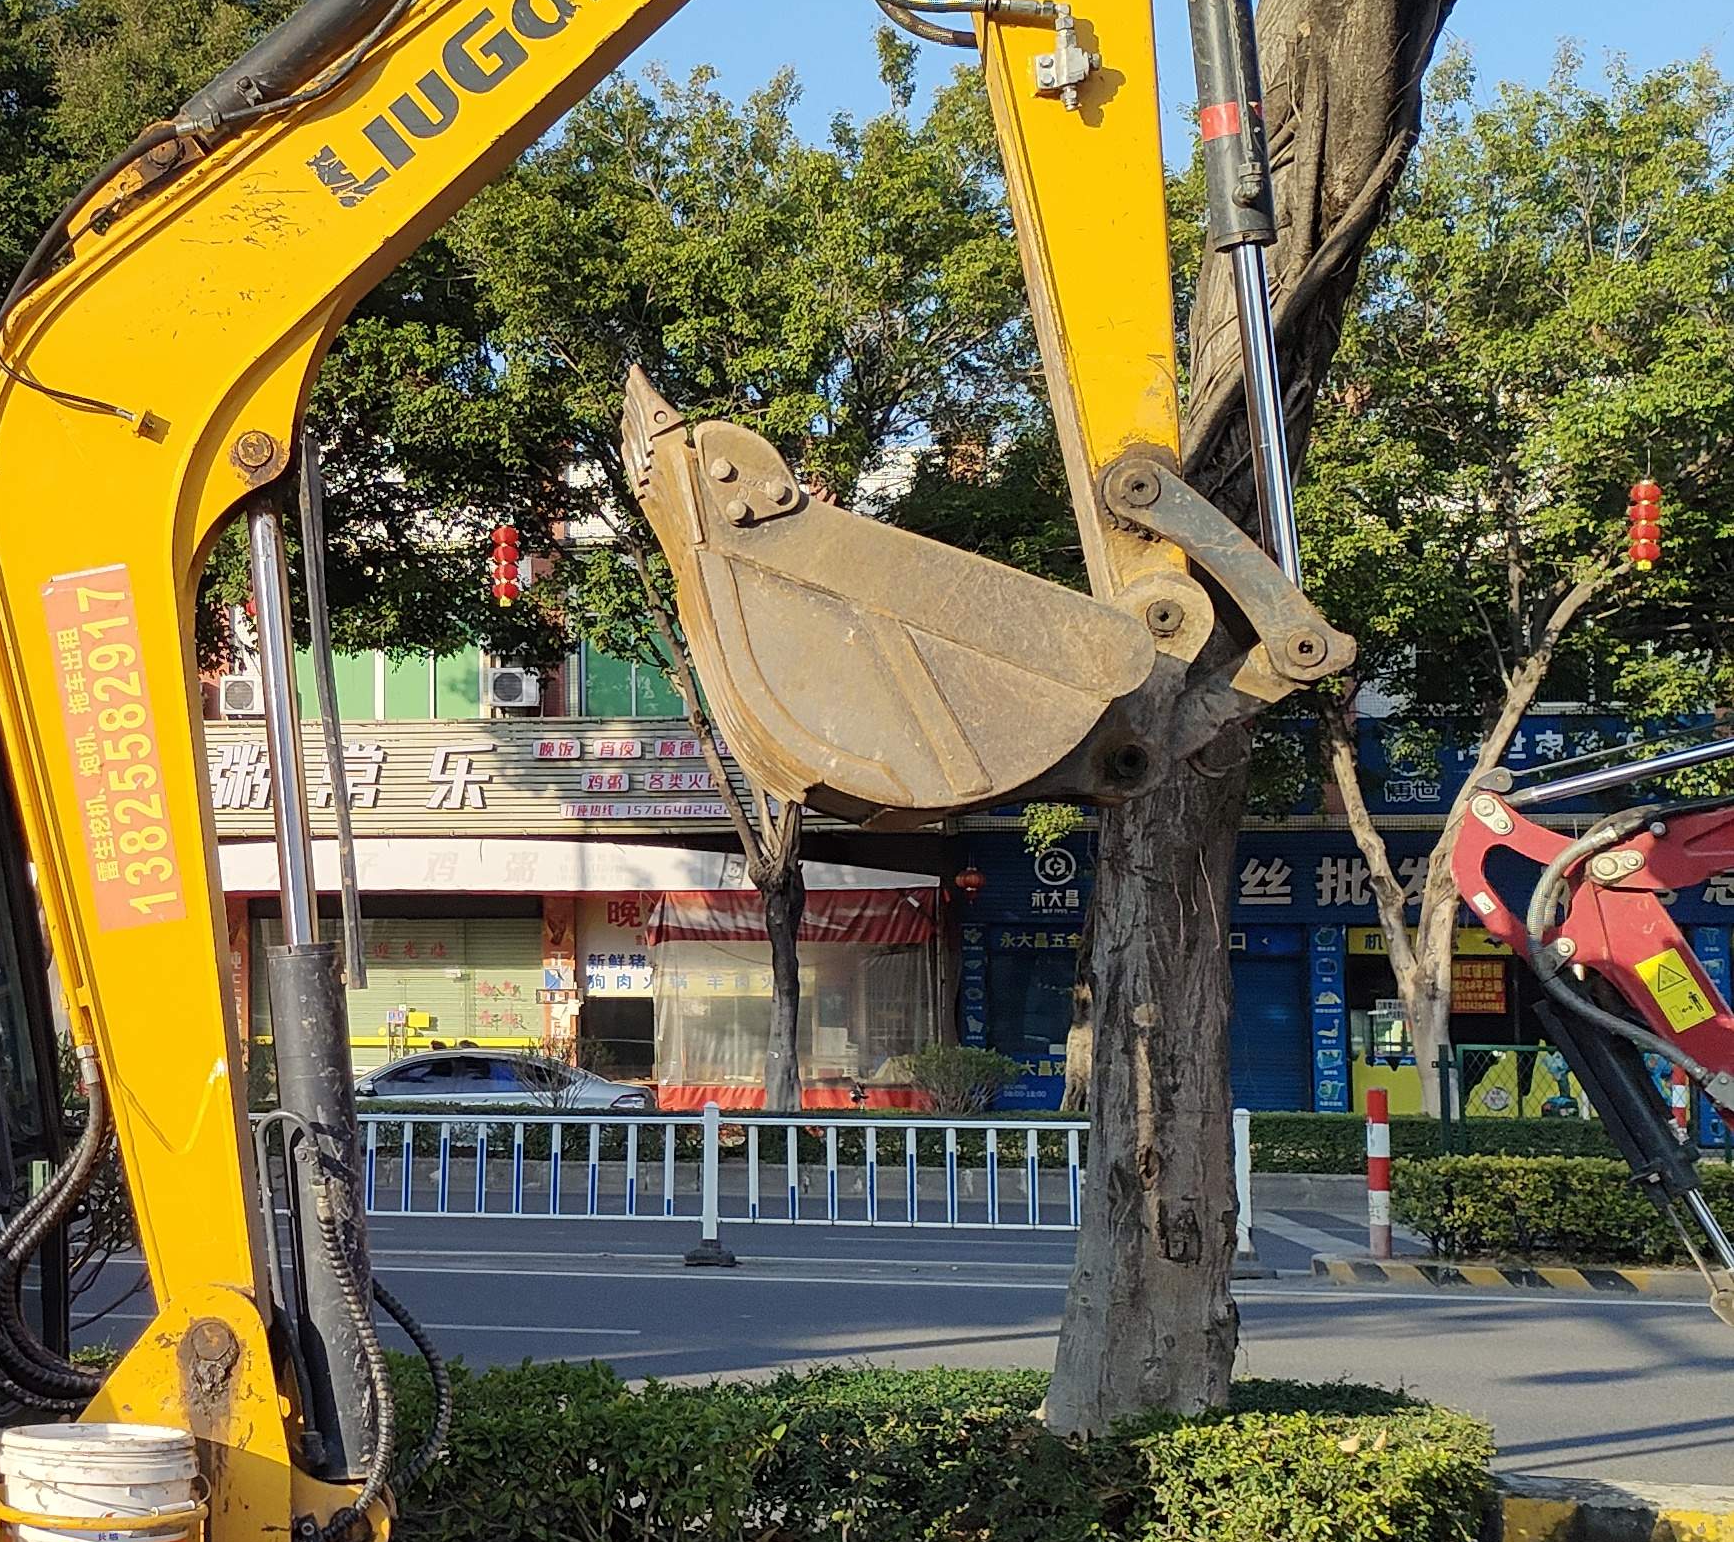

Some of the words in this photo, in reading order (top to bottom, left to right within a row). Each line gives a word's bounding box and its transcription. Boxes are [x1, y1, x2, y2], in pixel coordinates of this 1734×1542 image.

[76, 586, 179, 916] 13825582917
[537, 740, 575, 757] 晚饭
[598, 740, 636, 757] 宵夜
[586, 774, 623, 791] 鸡粥
[1384, 780, 1441, 803] 博世
[1031, 889, 1080, 908] 永大昌
